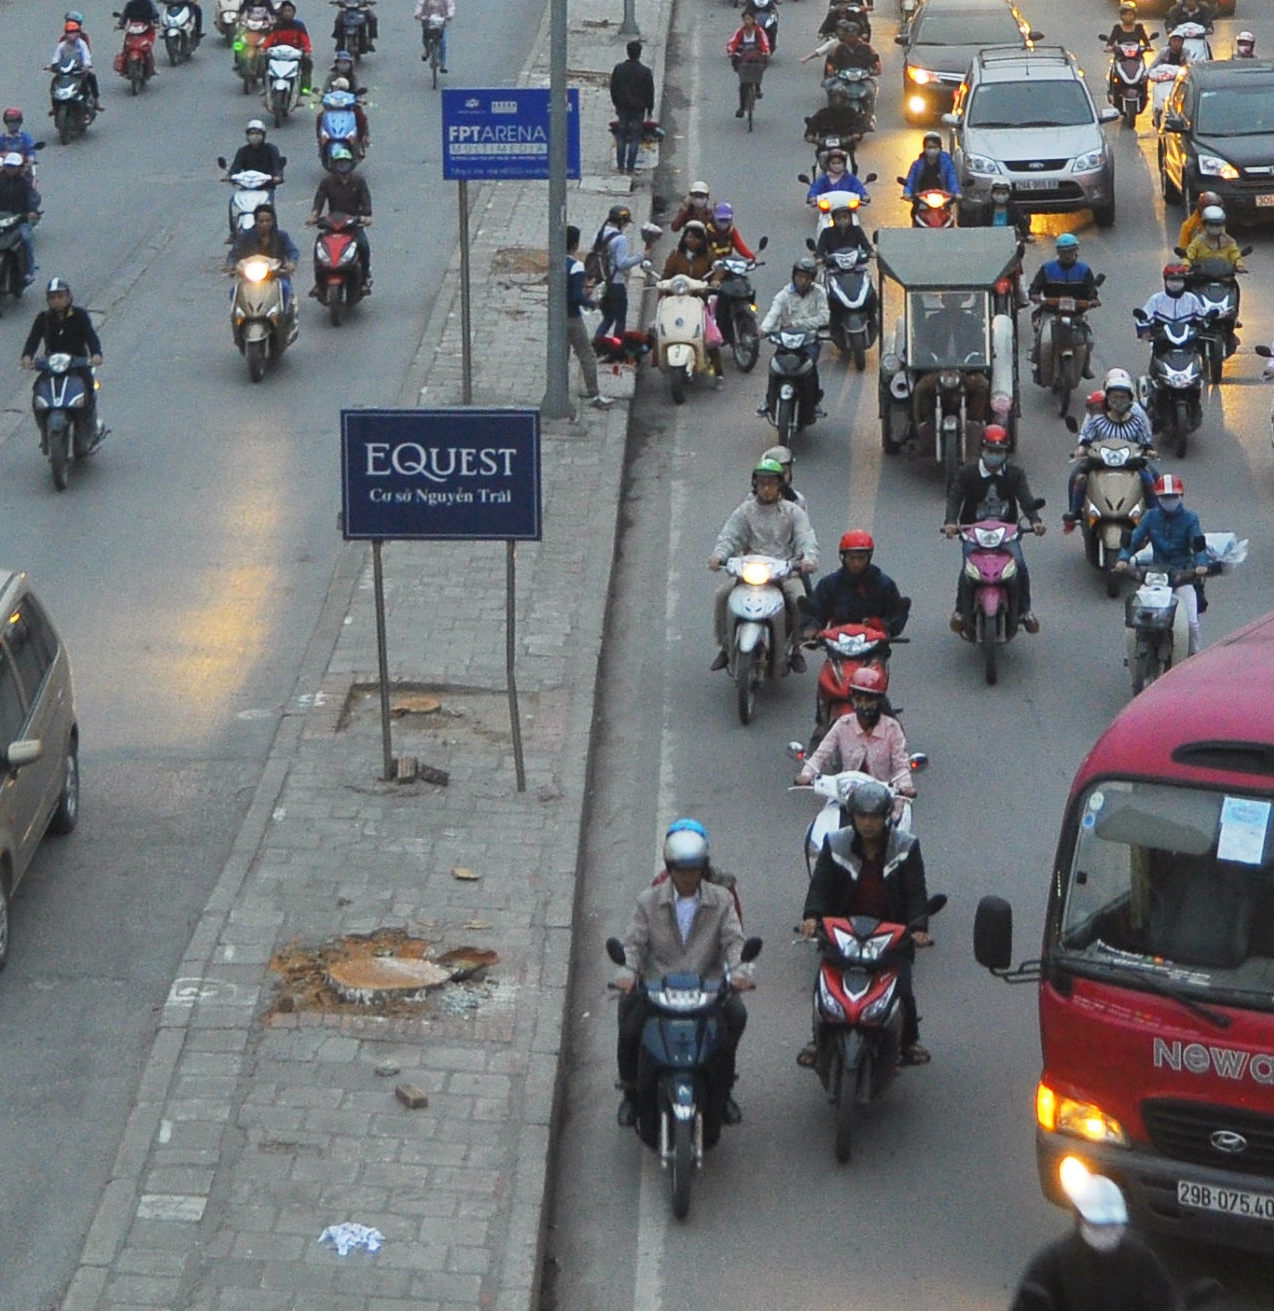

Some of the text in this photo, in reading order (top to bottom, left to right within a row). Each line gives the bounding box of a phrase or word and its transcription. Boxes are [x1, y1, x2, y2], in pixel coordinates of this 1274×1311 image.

[364, 442, 517, 483] EQUEST
[369, 489, 392, 503] Cơ
[395, 488, 412, 503] sở
